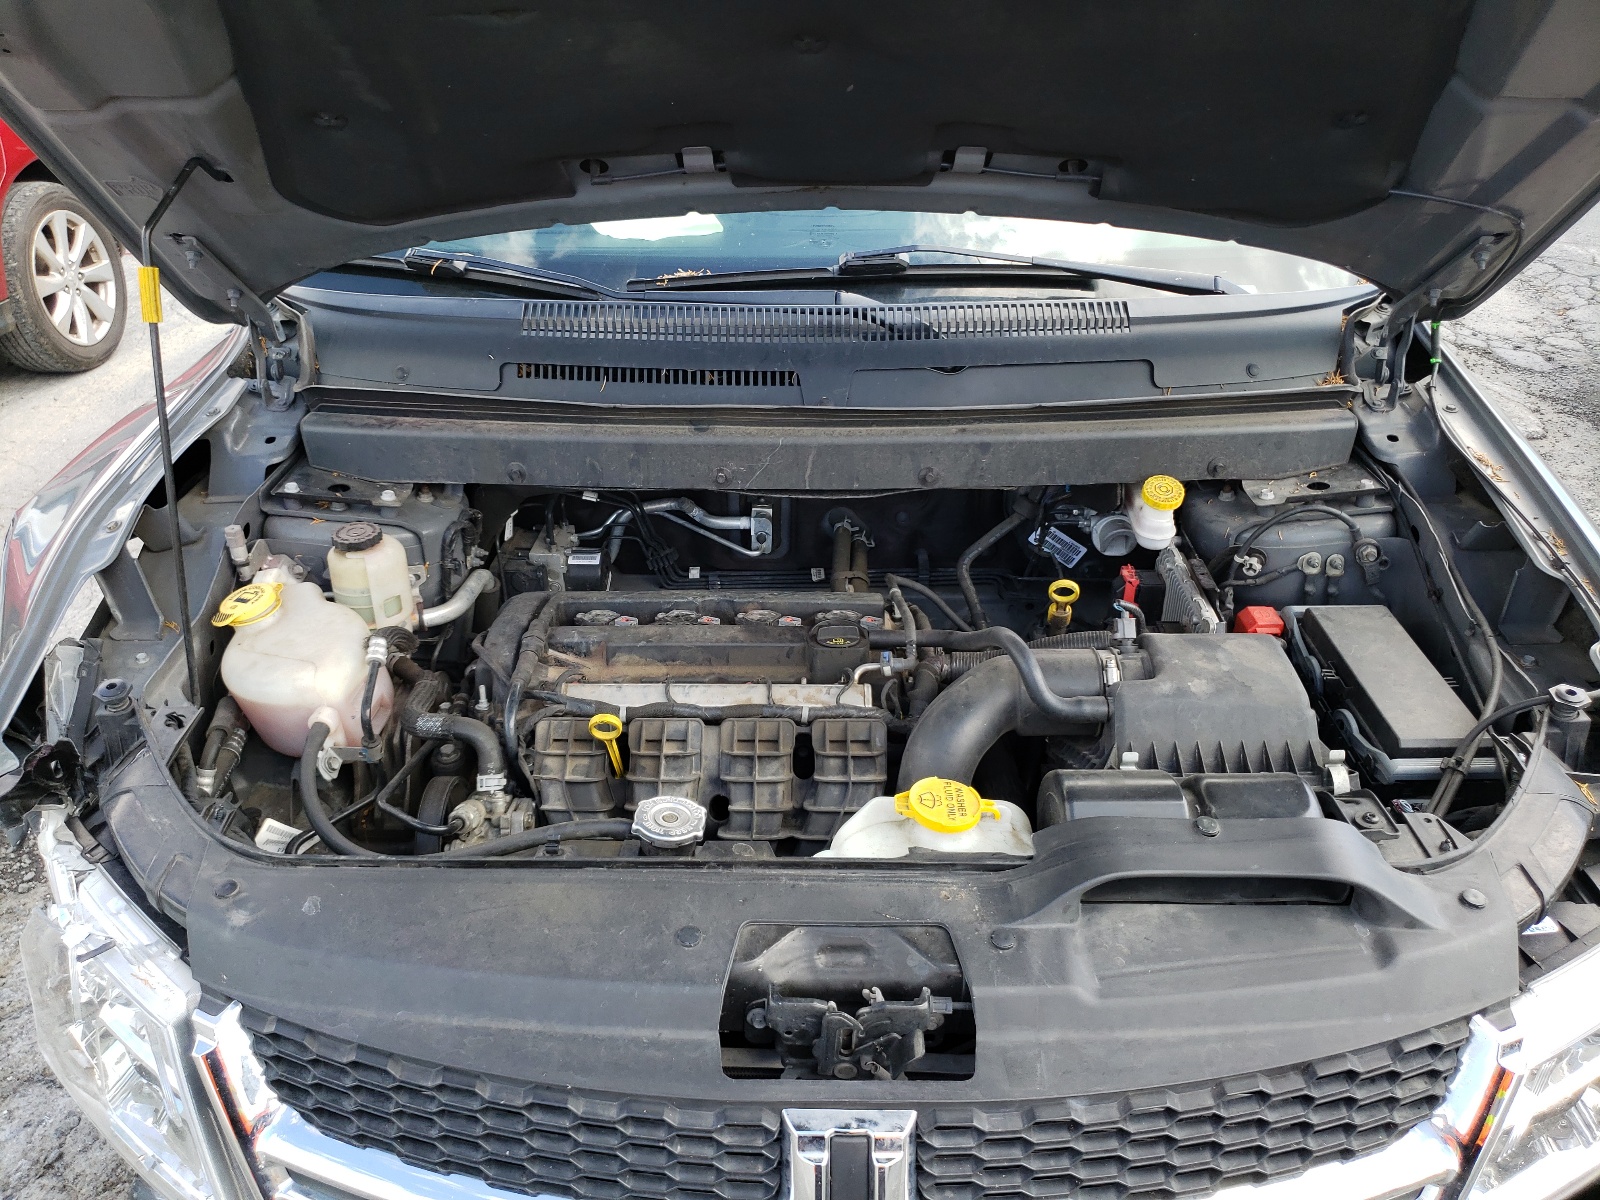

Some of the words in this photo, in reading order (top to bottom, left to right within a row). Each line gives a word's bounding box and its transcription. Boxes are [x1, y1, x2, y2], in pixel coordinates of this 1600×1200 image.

[944, 781, 954, 802] FLUID
[955, 787, 967, 817] WASHER
[946, 803, 957, 821] ONLY
